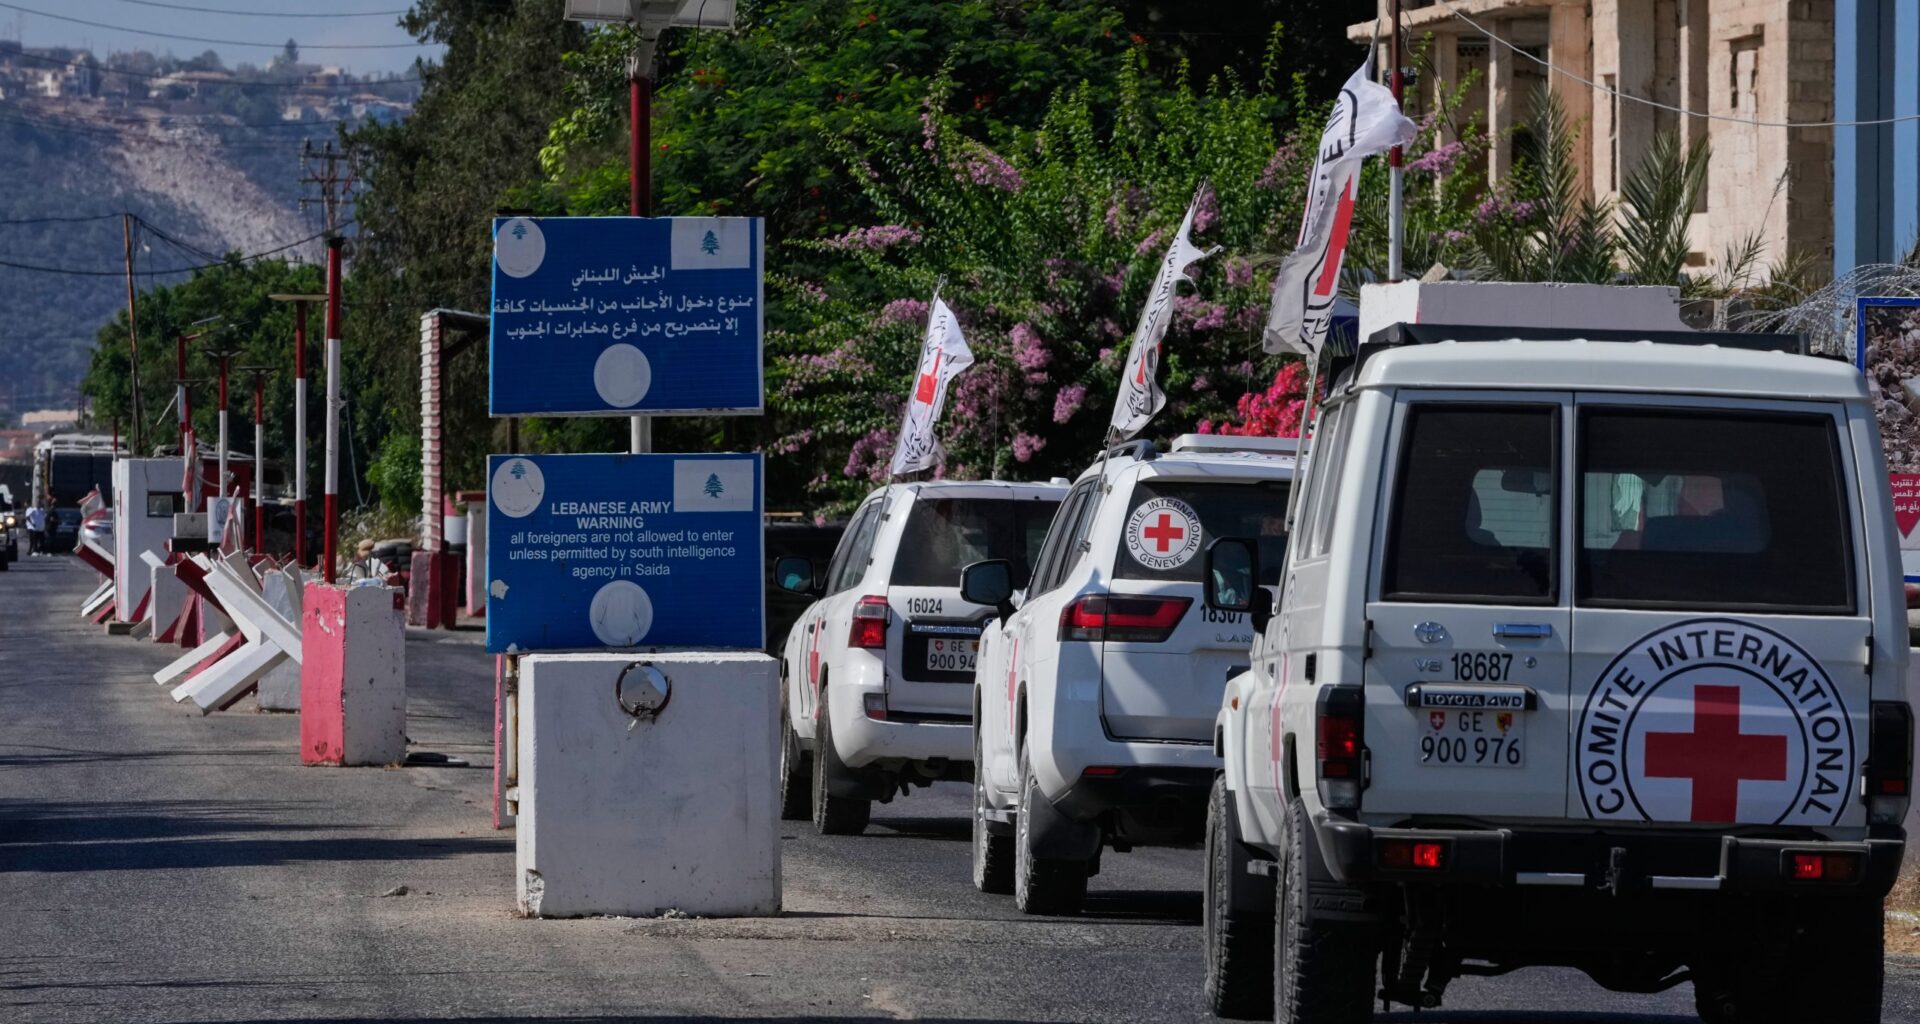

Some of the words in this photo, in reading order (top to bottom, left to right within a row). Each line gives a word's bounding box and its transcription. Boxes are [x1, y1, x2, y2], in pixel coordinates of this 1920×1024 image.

[571, 267, 620, 292] اللبناني
[623, 264, 666, 285] الجيش
[493, 298, 526, 314] كافة
[529, 297, 594, 316] الجنسيات
[597, 300, 618, 315] من
[620, 290, 673, 311] الأجانب
[676, 295, 714, 313] دخول
[506, 321, 551, 340] الجنوب
[554, 321, 609, 339] مخابرات
[611, 318, 638, 340] فرع
[641, 322, 661, 335] من
[664, 320, 721, 338] بتصريح
[724, 317, 739, 336] إلا
[551, 502, 626, 516] LEBANESE
[629, 501, 672, 515] ARMY
[576, 516, 644, 530] WARNING
[1128, 510, 1145, 551] COMITE
[1147, 498, 1200, 553] INTERNATIONAL
[510, 531, 524, 545] all
[527, 531, 588, 547] foreigners
[590, 533, 611, 543] are
[614, 531, 634, 543] not
[636, 529, 684, 543] allowed
[686, 530, 699, 543] to
[701, 530, 735, 542] enter
[509, 547, 548, 561] unless
[551, 546, 608, 562] permitted
[611, 546, 627, 562] by
[629, 545, 664, 559] south
[667, 545, 736, 561] intelligence
[1139, 553, 1185, 568] GENEVE
[572, 566, 617, 581] agency
[620, 563, 632, 576] in
[635, 563, 671, 576] Saida
[907, 597, 943, 614] 16024
[1215, 632, 1253, 643] LAN
[950, 641, 965, 653] GE
[929, 653, 956, 669] 900
[959, 654, 976, 670] 94
[1451, 652, 1514, 682] 18687
[1427, 694, 1483, 706] TOYOTA
[1487, 695, 1523, 707] 4WD
[1458, 711, 1484, 733] GE
[1588, 666, 1646, 816] COMITE
[1647, 629, 1844, 818] INTERNATIONAL
[1420, 736, 1467, 764] 900
[1474, 737, 1521, 766] 976
